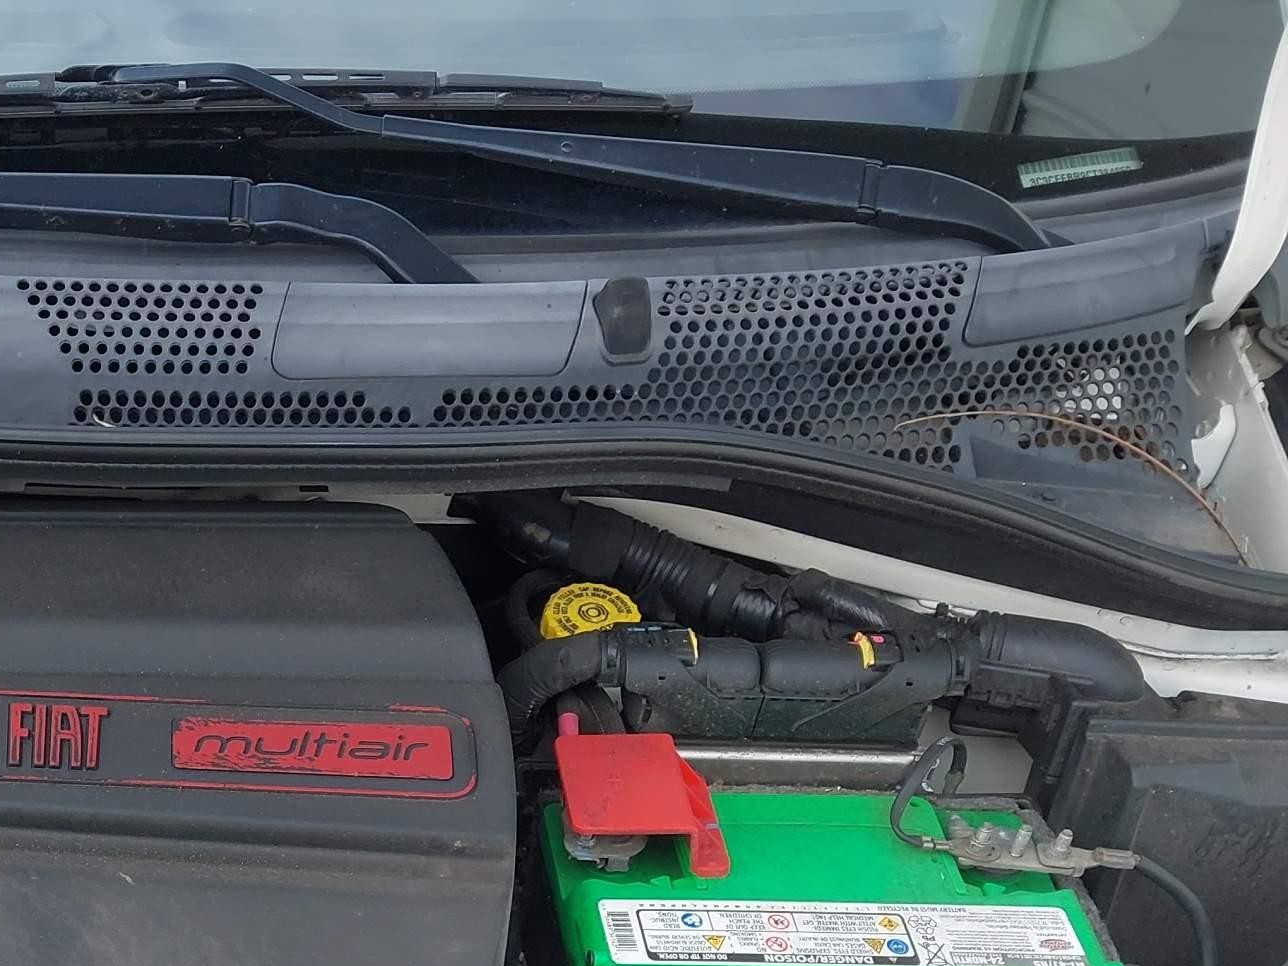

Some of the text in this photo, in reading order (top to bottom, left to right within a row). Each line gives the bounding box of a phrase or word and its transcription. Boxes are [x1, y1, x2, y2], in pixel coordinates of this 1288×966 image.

[593, 586, 614, 597] BEFORE
[7, 703, 429, 770] FIAT multiair
[763, 955, 874, 964] DANGER/POISON
[952, 955, 1005, 965] 24-MONTH
